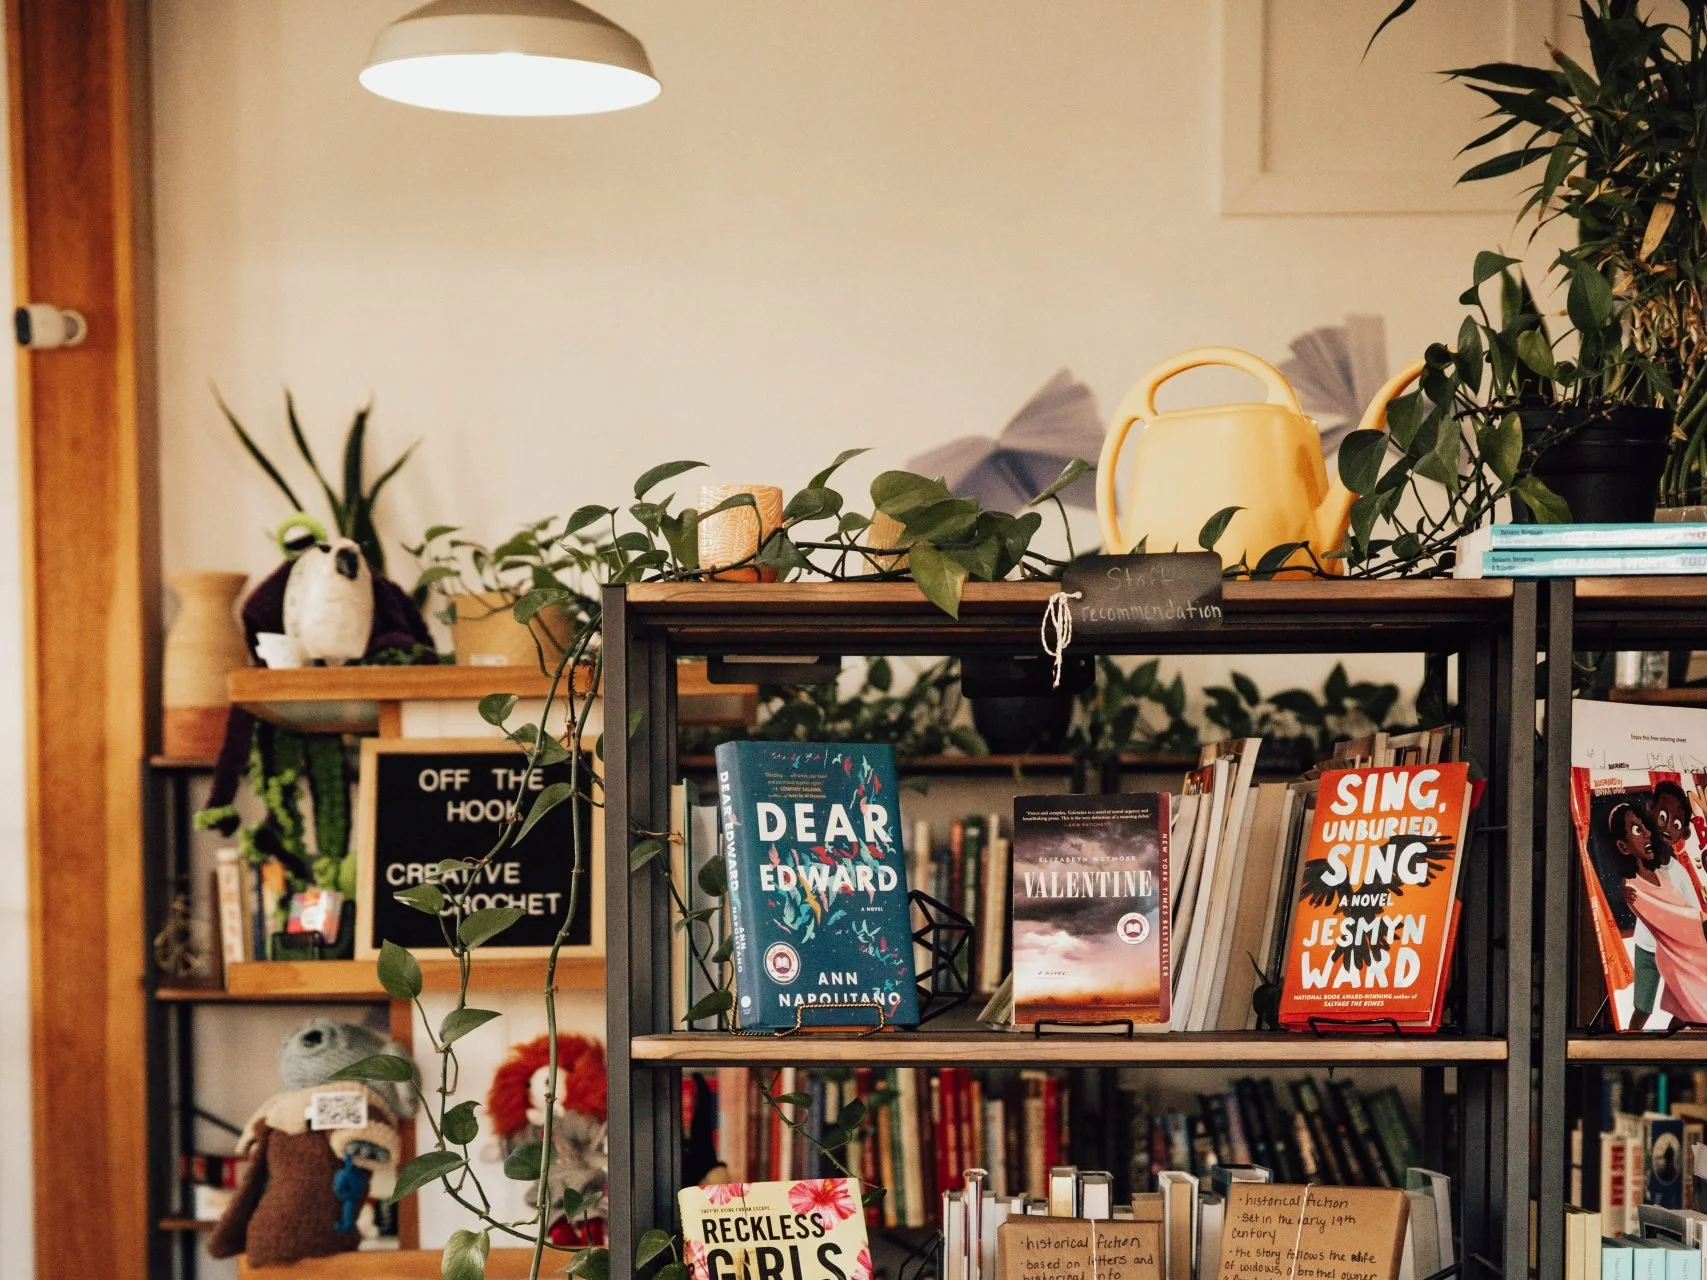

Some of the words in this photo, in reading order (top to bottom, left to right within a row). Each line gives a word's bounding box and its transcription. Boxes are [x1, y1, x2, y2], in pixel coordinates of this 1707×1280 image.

[1082, 600, 1222, 622] recommendation
[418, 769, 470, 793] OFF
[491, 768, 545, 791] THE
[1330, 769, 1446, 816] SING,
[720, 771, 732, 816] DEAR
[447, 800, 524, 823] HOOK
[756, 802, 892, 842] DEAR
[1322, 816, 1442, 842] UNBURIED,
[724, 823, 739, 892] EDWARD
[1320, 842, 1428, 886] SING
[760, 864, 898, 892] EDWARD
[1024, 870, 1152, 898] VALENTINE
[1338, 895, 1348, 907] A
[1351, 893, 1394, 907] NOVEL
[732, 906, 742, 974] NAPOLITANO
[738, 928, 746, 950] ANN
[1302, 914, 1426, 947] JESMYN
[818, 972, 858, 986] ANN
[1301, 947, 1420, 990] WARD
[778, 992, 901, 1007] NAPOLITANO
[1245, 1193, 1300, 1206] historical
[1306, 1194, 1348, 1209] fiction
[702, 1212, 826, 1244] RECKLESS
[1263, 1216, 1272, 1224] in
[1278, 1214, 1294, 1225] the
[1026, 1236, 1089, 1250] historical
[1097, 1233, 1140, 1248] fiction
[1027, 1258, 1060, 1270] based
[1134, 1254, 1154, 1264] and
[1235, 1248, 1251, 1258] the
[1256, 1249, 1281, 1264] story
[1287, 1250, 1325, 1261] follows
[1329, 1251, 1346, 1261] the
[1225, 1260, 1235, 1270] of
[1298, 1268, 1335, 1279] brothel
